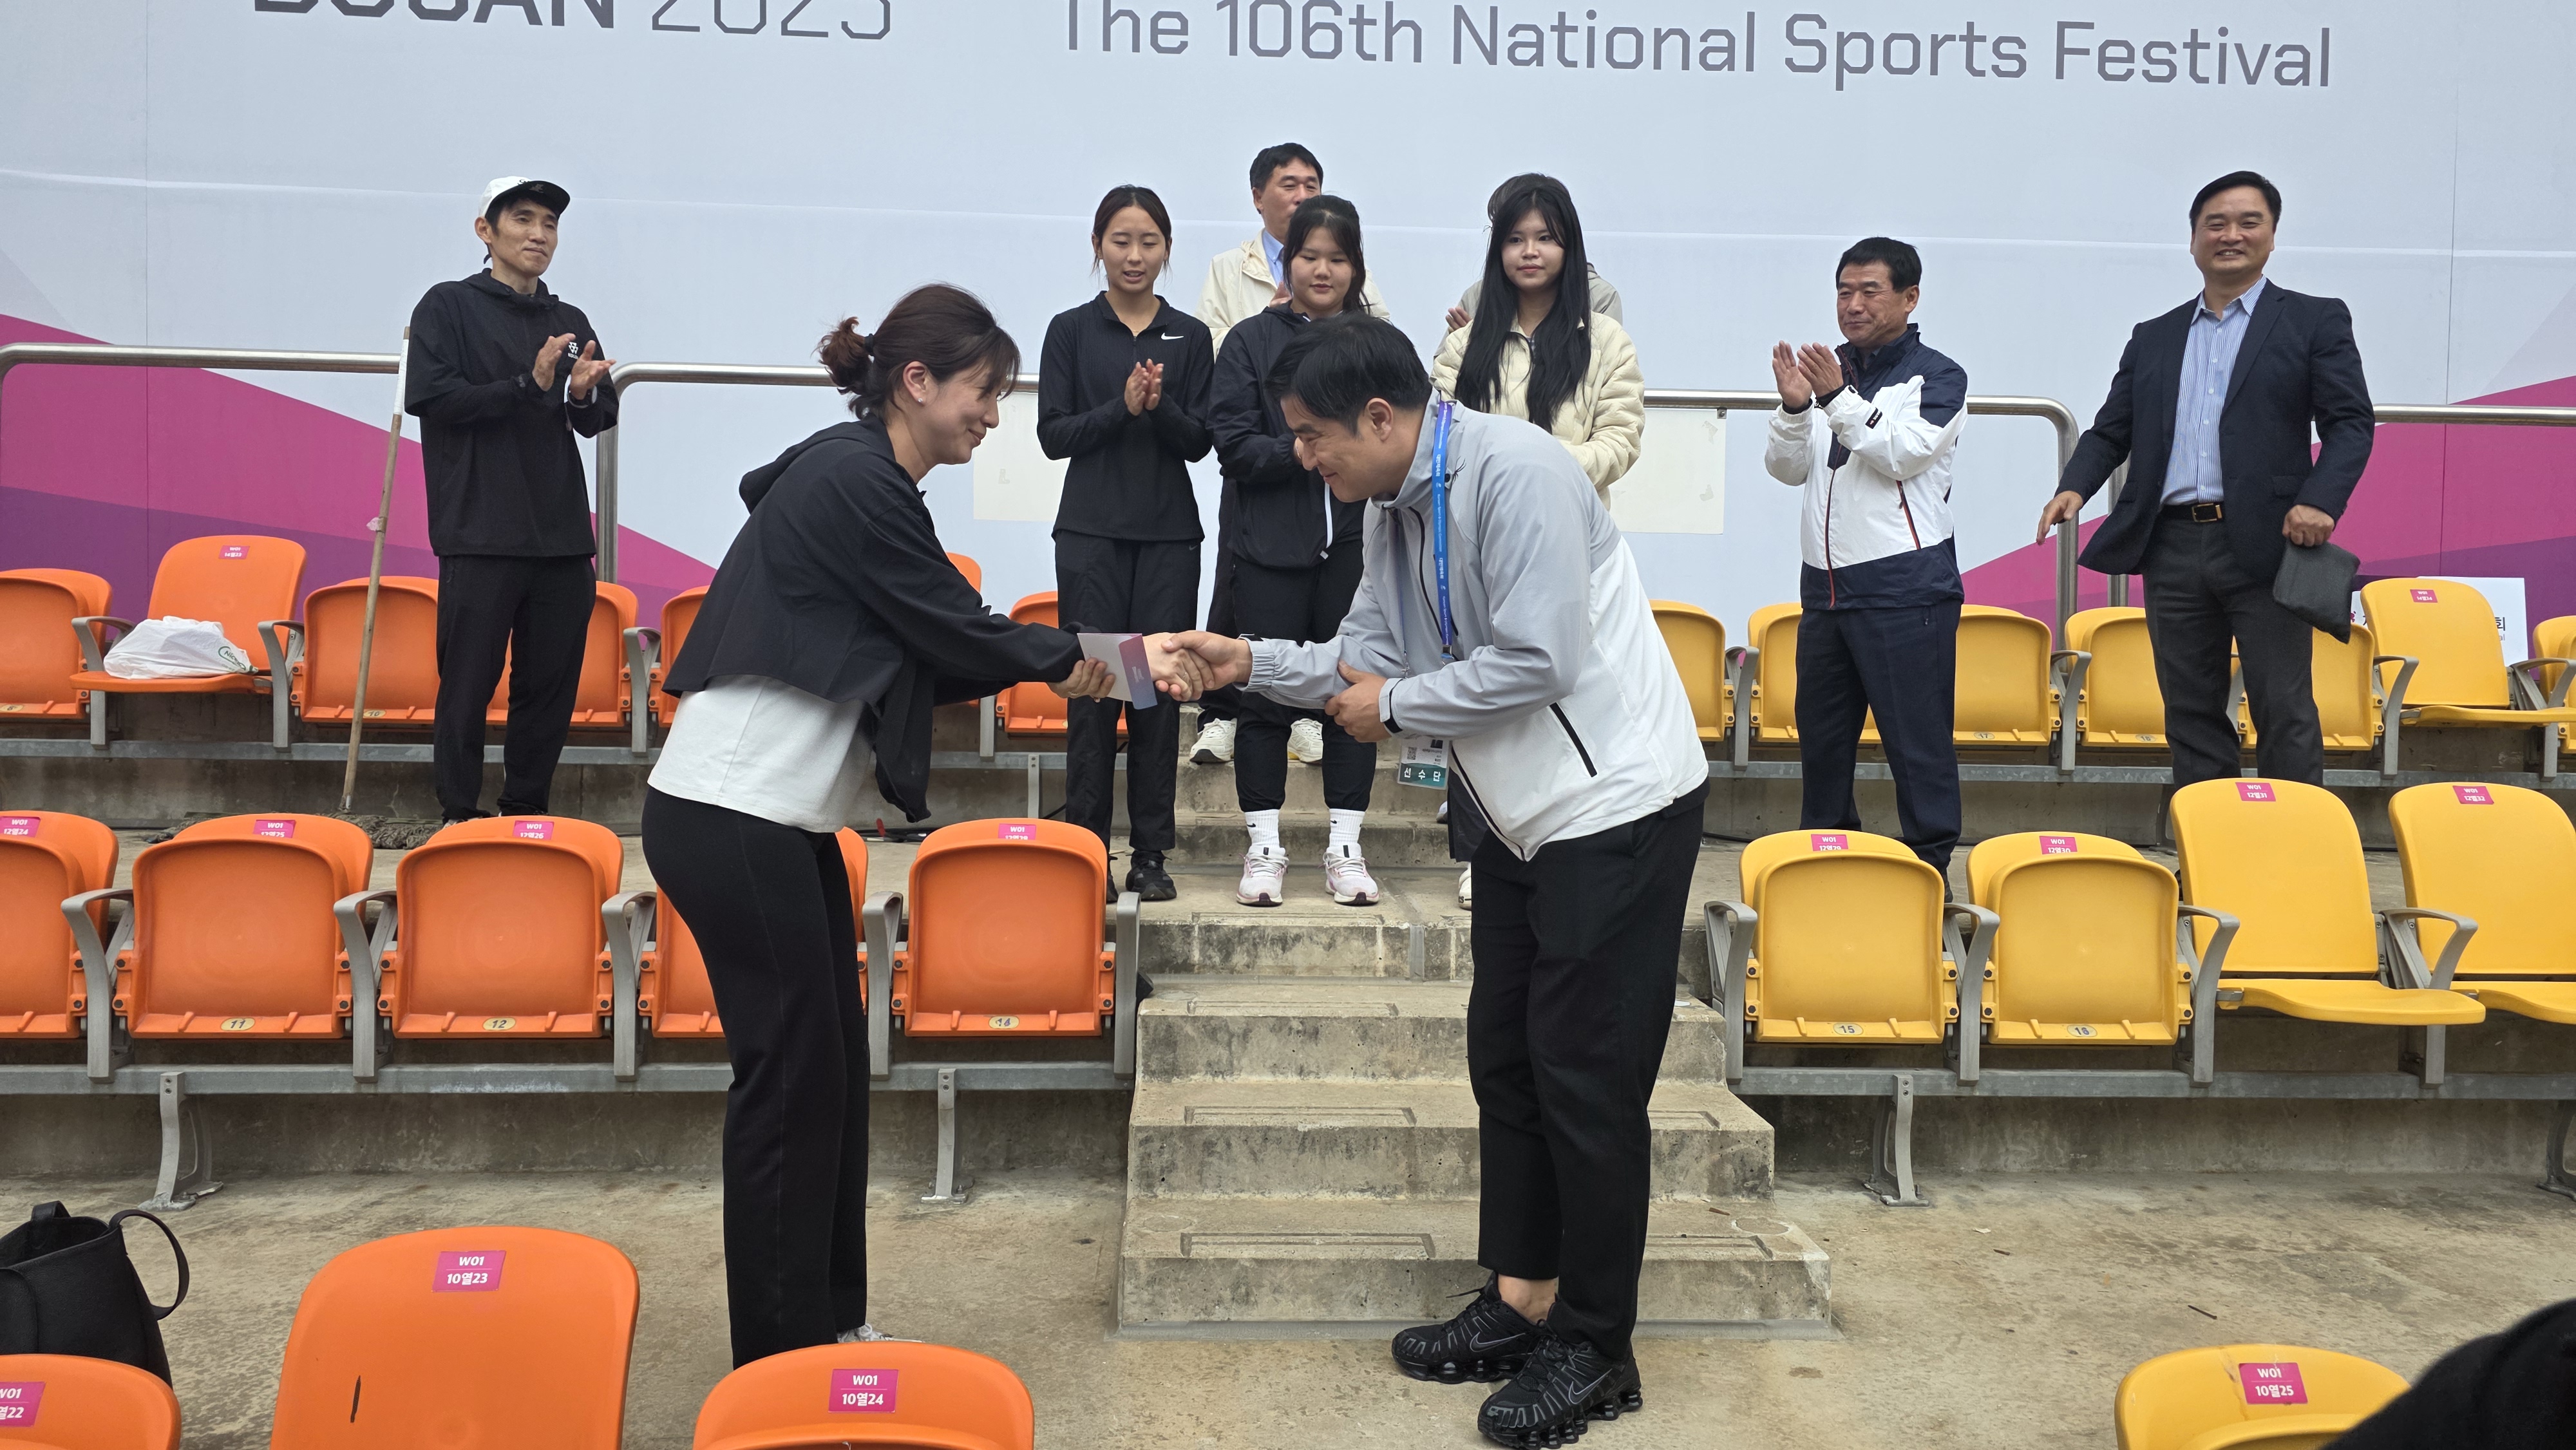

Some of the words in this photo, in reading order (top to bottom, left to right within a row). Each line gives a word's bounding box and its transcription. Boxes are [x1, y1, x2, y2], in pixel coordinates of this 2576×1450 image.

[1217, 0, 1421, 62] 106th
[1454, 5, 1754, 71] National
[1785, 14, 2026, 91] Sports
[2056, 21, 2329, 86] Festival
[492, 1020, 507, 1028] 12
[459, 1256, 484, 1266] W01
[448, 1272, 488, 1285] 10열23
[2257, 1368, 2282, 1378] W01
[853, 1375, 878, 1385] W01
[2255, 1384, 2294, 1397] 10열25
[842, 1393, 884, 1406] 10열24
